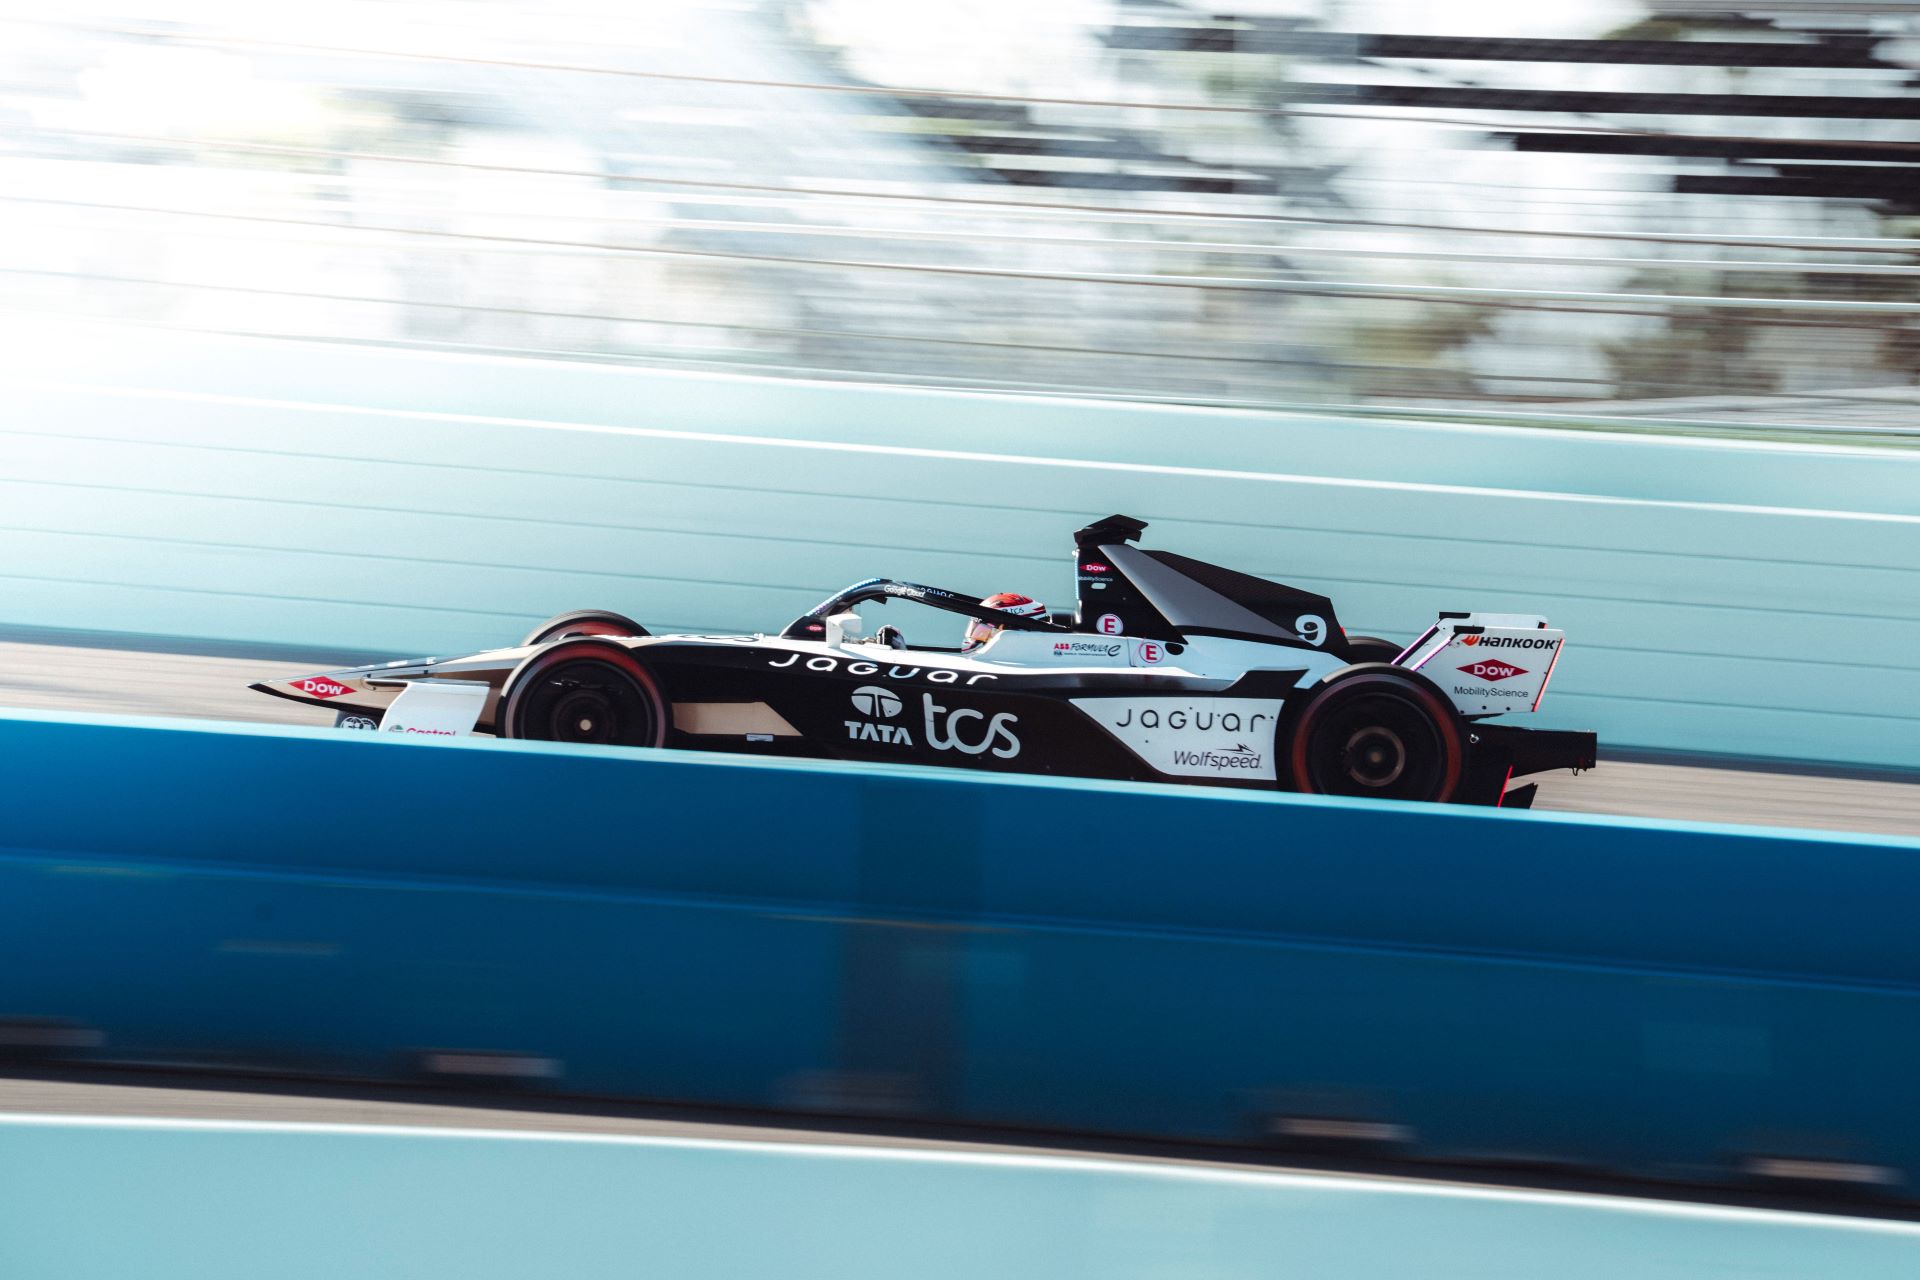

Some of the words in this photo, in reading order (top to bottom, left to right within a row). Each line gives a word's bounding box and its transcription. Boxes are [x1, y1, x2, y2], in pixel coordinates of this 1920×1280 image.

[884, 584, 908, 596] Google
[1104, 618, 1115, 633] E
[1295, 614, 1327, 647] 9
[1071, 643, 1108, 652] FORMULA
[1146, 645, 1157, 660] E
[1474, 664, 1514, 676] Dow
[303, 680, 343, 695] Dow
[1454, 686, 1529, 698] MobilityScience
[922, 692, 1021, 759] tcs
[844, 721, 913, 746] TATA
